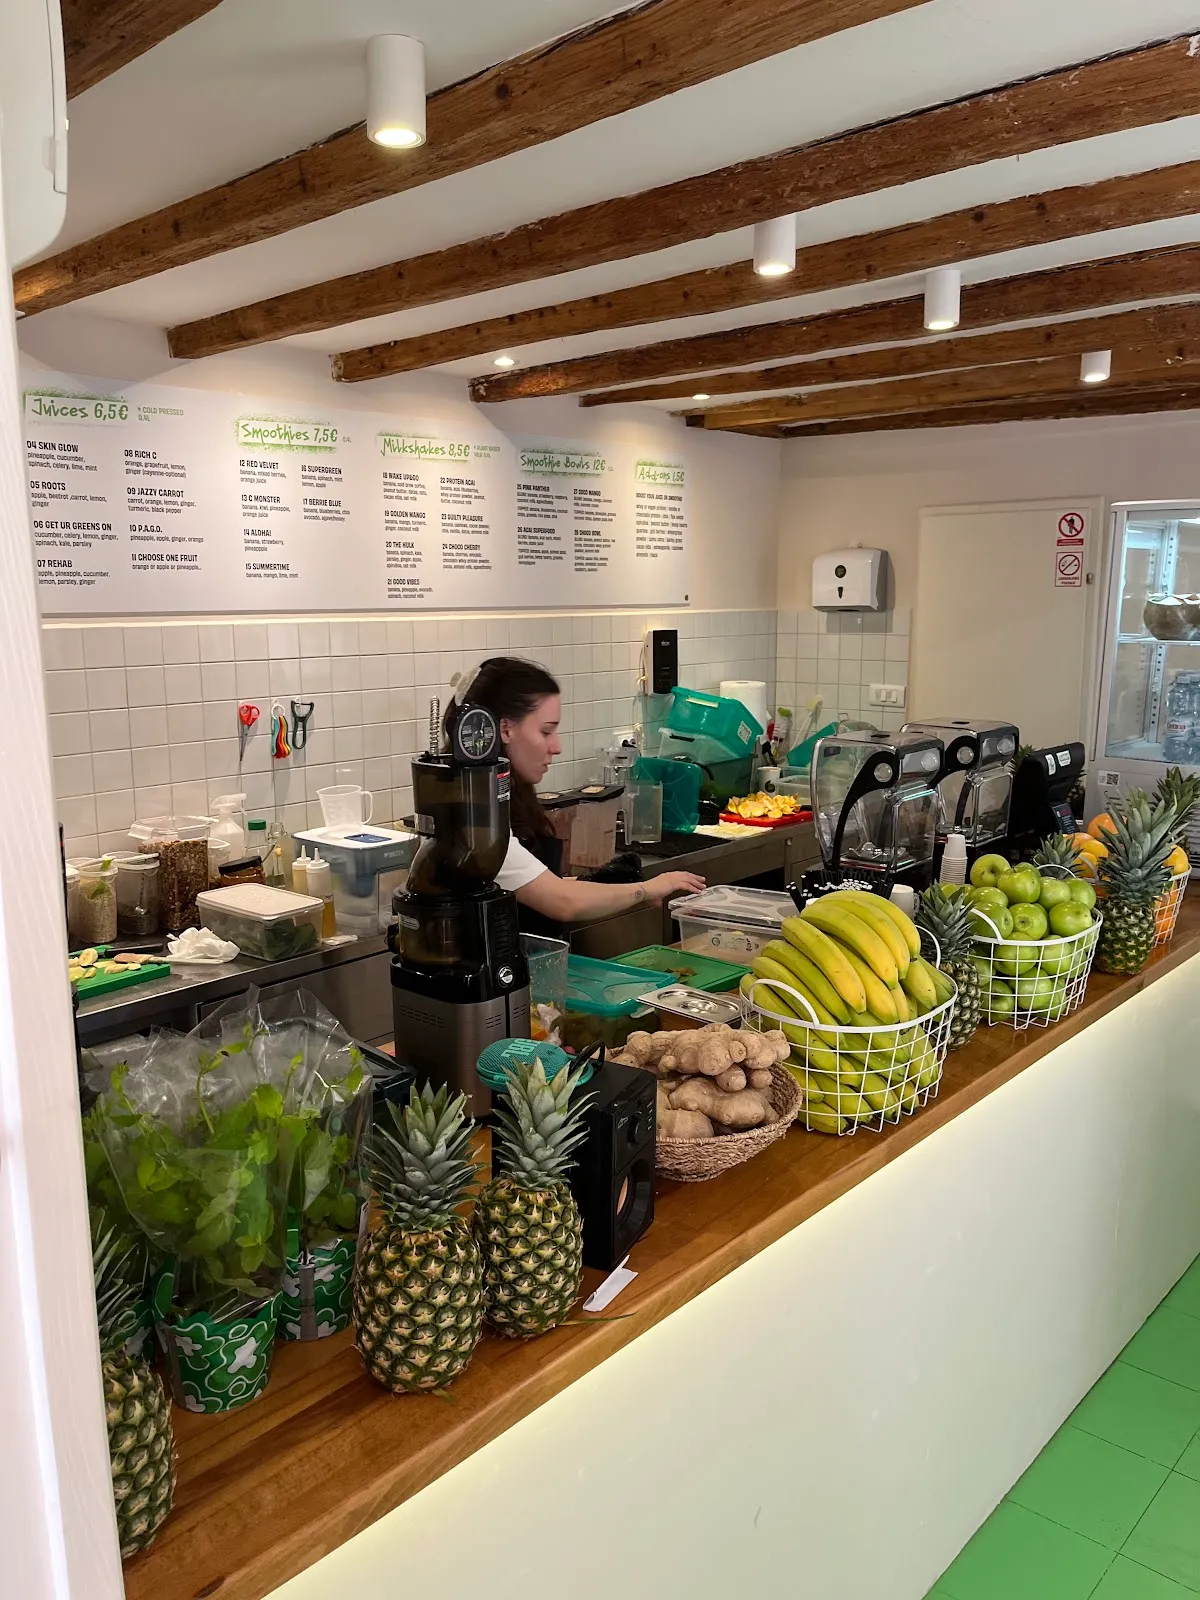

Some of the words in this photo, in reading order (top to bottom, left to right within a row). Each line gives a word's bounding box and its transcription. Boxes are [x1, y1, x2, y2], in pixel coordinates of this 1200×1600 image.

[32, 398, 88, 419] Juices
[94, 403, 128, 420] 6,5€
[241, 423, 309, 446] Smoothies
[314, 428, 338, 443] 7,5€
[27, 440, 37, 449] 04
[39, 442, 56, 451] SKIN
[58, 443, 78, 452] GLOW
[381, 438, 446, 459] Milkshakes
[448, 444, 470, 457] 8,5€
[28, 452, 55, 460] pineapple,
[57, 454, 85, 463] cucumber,
[135, 450, 150, 458] RICH
[53, 462, 71, 471] celery,
[259, 461, 279, 469] VELVET
[521, 455, 560, 472] Smoothie
[564, 456, 590, 469] Bowls
[308, 466, 341, 474] SUPERGREEN
[639, 467, 670, 483] Add-ons
[42, 482, 66, 490] ROOTS
[138, 488, 157, 496] JAZZY
[159, 489, 184, 497] CARROT
[254, 495, 280, 503] MONSTER
[73, 522, 100, 530] GREENS
